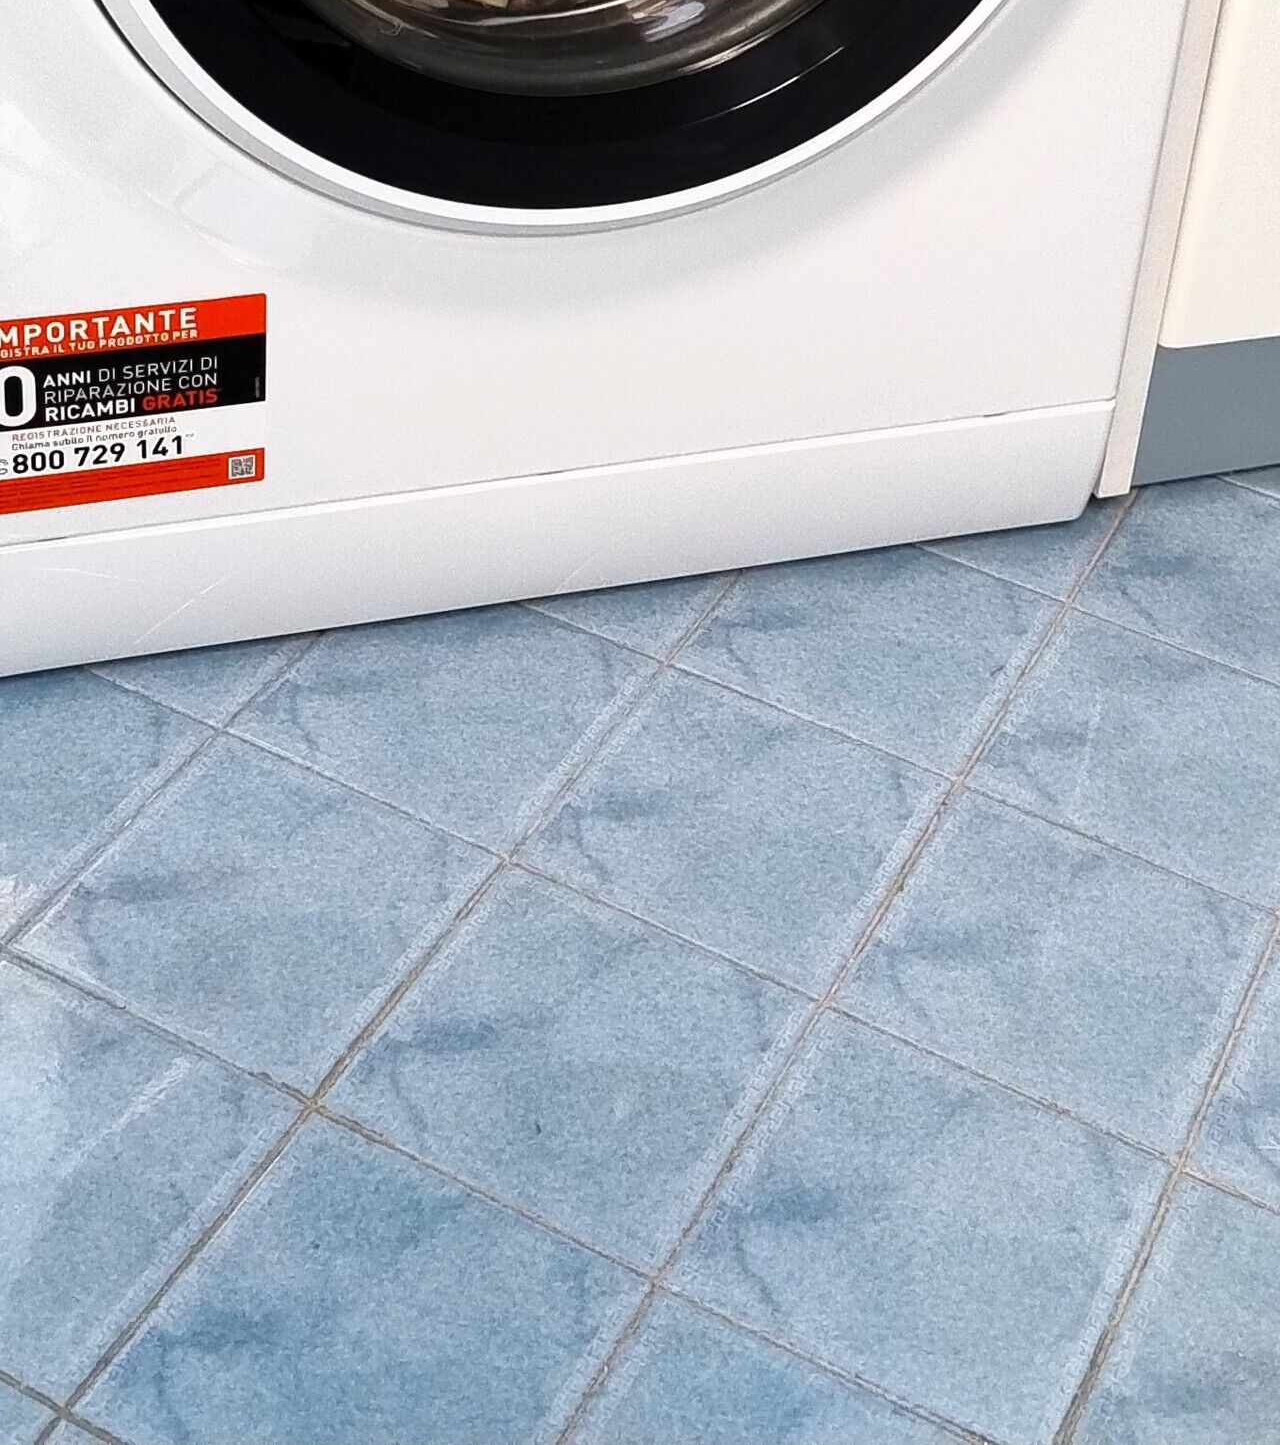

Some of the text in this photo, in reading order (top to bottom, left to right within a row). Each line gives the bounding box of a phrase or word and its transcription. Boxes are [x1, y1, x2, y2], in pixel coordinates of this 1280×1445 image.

[54, 343, 65, 353] IL
[69, 341, 95, 351] TUO
[100, 333, 169, 348] PRODOTTO
[172, 329, 198, 340] PER
[43, 356, 218, 388] ANNI DI SERVIZI DI
[44, 373, 218, 404] RIPARAZIONE CON
[45, 388, 218, 422] RICAMBI GRATIS
[12, 417, 176, 441] REGISTRAZIONE NECESSARIA
[12, 435, 183, 474] 800 729 141
